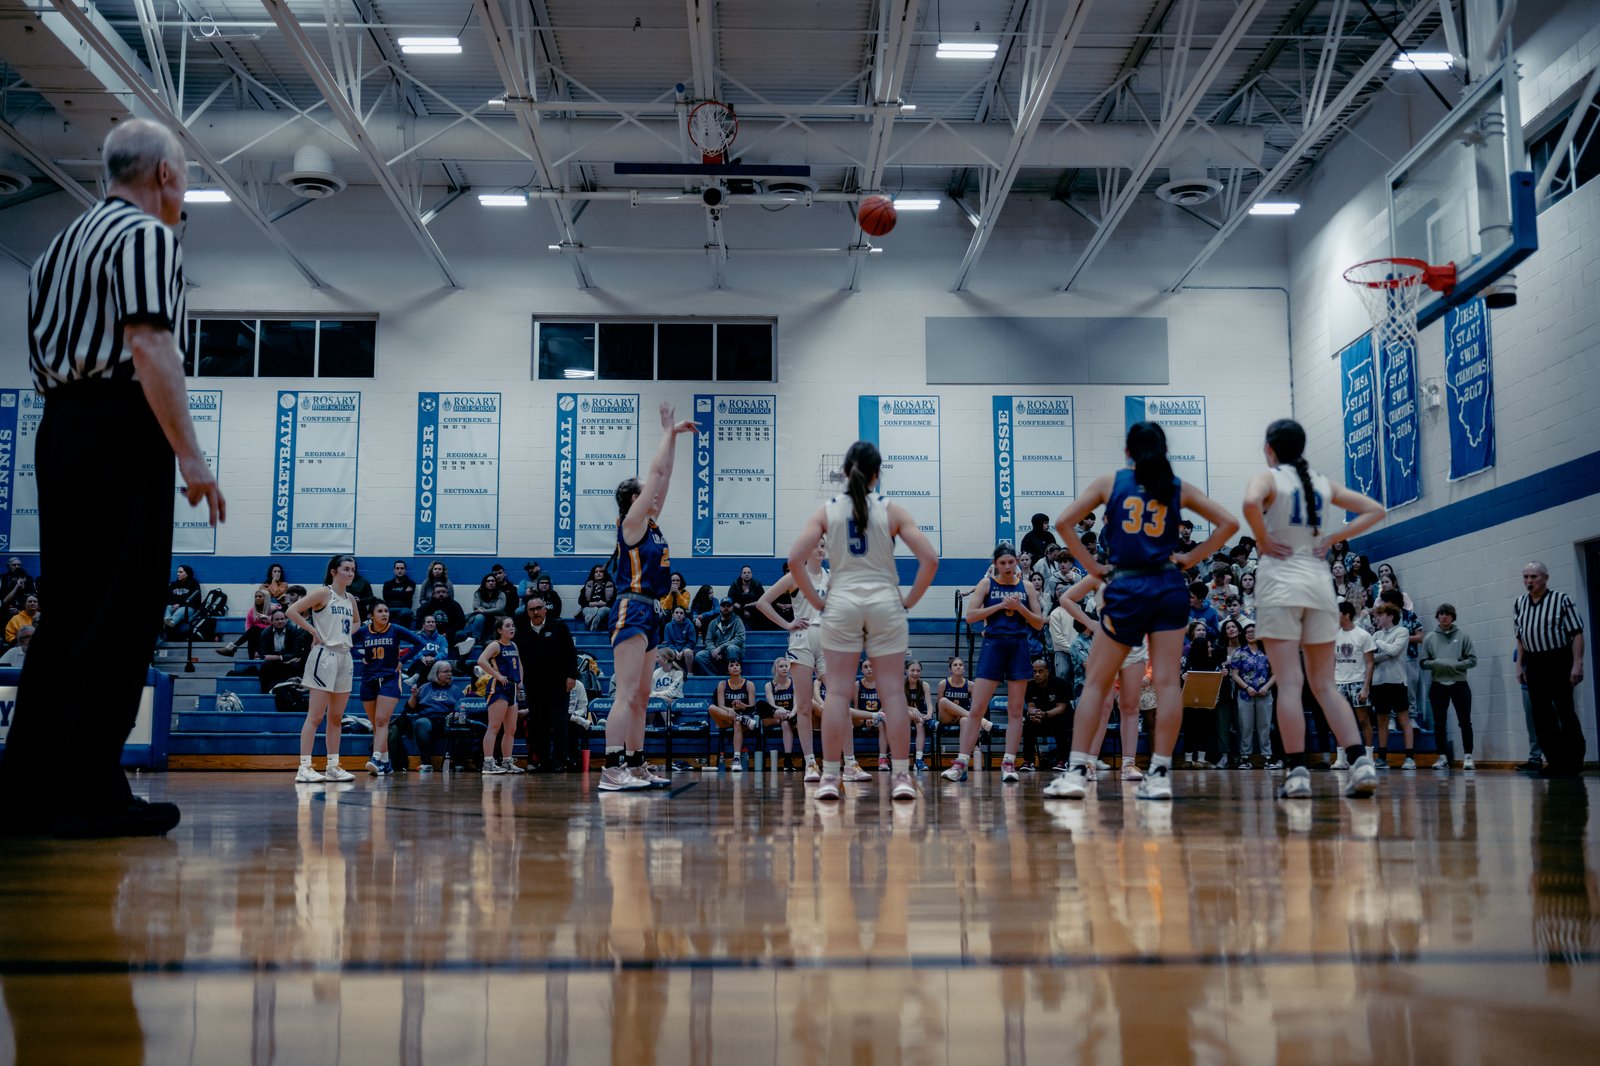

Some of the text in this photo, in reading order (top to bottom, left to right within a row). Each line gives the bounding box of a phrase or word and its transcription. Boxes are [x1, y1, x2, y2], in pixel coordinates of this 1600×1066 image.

[1460, 301, 1479, 325] IHSA
[1456, 319, 1480, 347] STATE
[1460, 341, 1479, 365] SWIM
[1390, 365, 1408, 389] STATE
[1456, 358, 1486, 387] CHAMPIONS
[1354, 373, 1368, 392] IHSA
[1464, 380, 1483, 402] 2017
[190, 394, 216, 403] SARY
[312, 396, 356, 405] ROSARY
[454, 398, 496, 406] ROSARY
[592, 398, 634, 407] ROSARY
[729, 400, 770, 408] ROSARY
[894, 400, 935, 409] ROSARY
[1027, 400, 1068, 409] ROSARY
[1160, 401, 1200, 409] ROSARY
[1350, 389, 1370, 411] STATE
[1392, 386, 1408, 405] SWIM
[1353, 406, 1369, 426] SWIM
[1349, 421, 1374, 445] CHAMPIONS
[1397, 420, 1412, 439] 2016
[1358, 440, 1372, 458] 2015
[276, 412, 292, 532] BASKETBALL
[421, 424, 434, 522] SOCCER
[559, 418, 572, 530] SOFTBALL
[698, 431, 710, 519] TRACK
[998, 410, 1011, 524] LaCROSSE
[1122, 496, 1168, 537] 33
[846, 518, 868, 558] 5
[331, 606, 352, 616] ROYAL
[342, 618, 350, 635] 13
[364, 638, 392, 647] CHARGERS
[372, 646, 384, 660] 10
